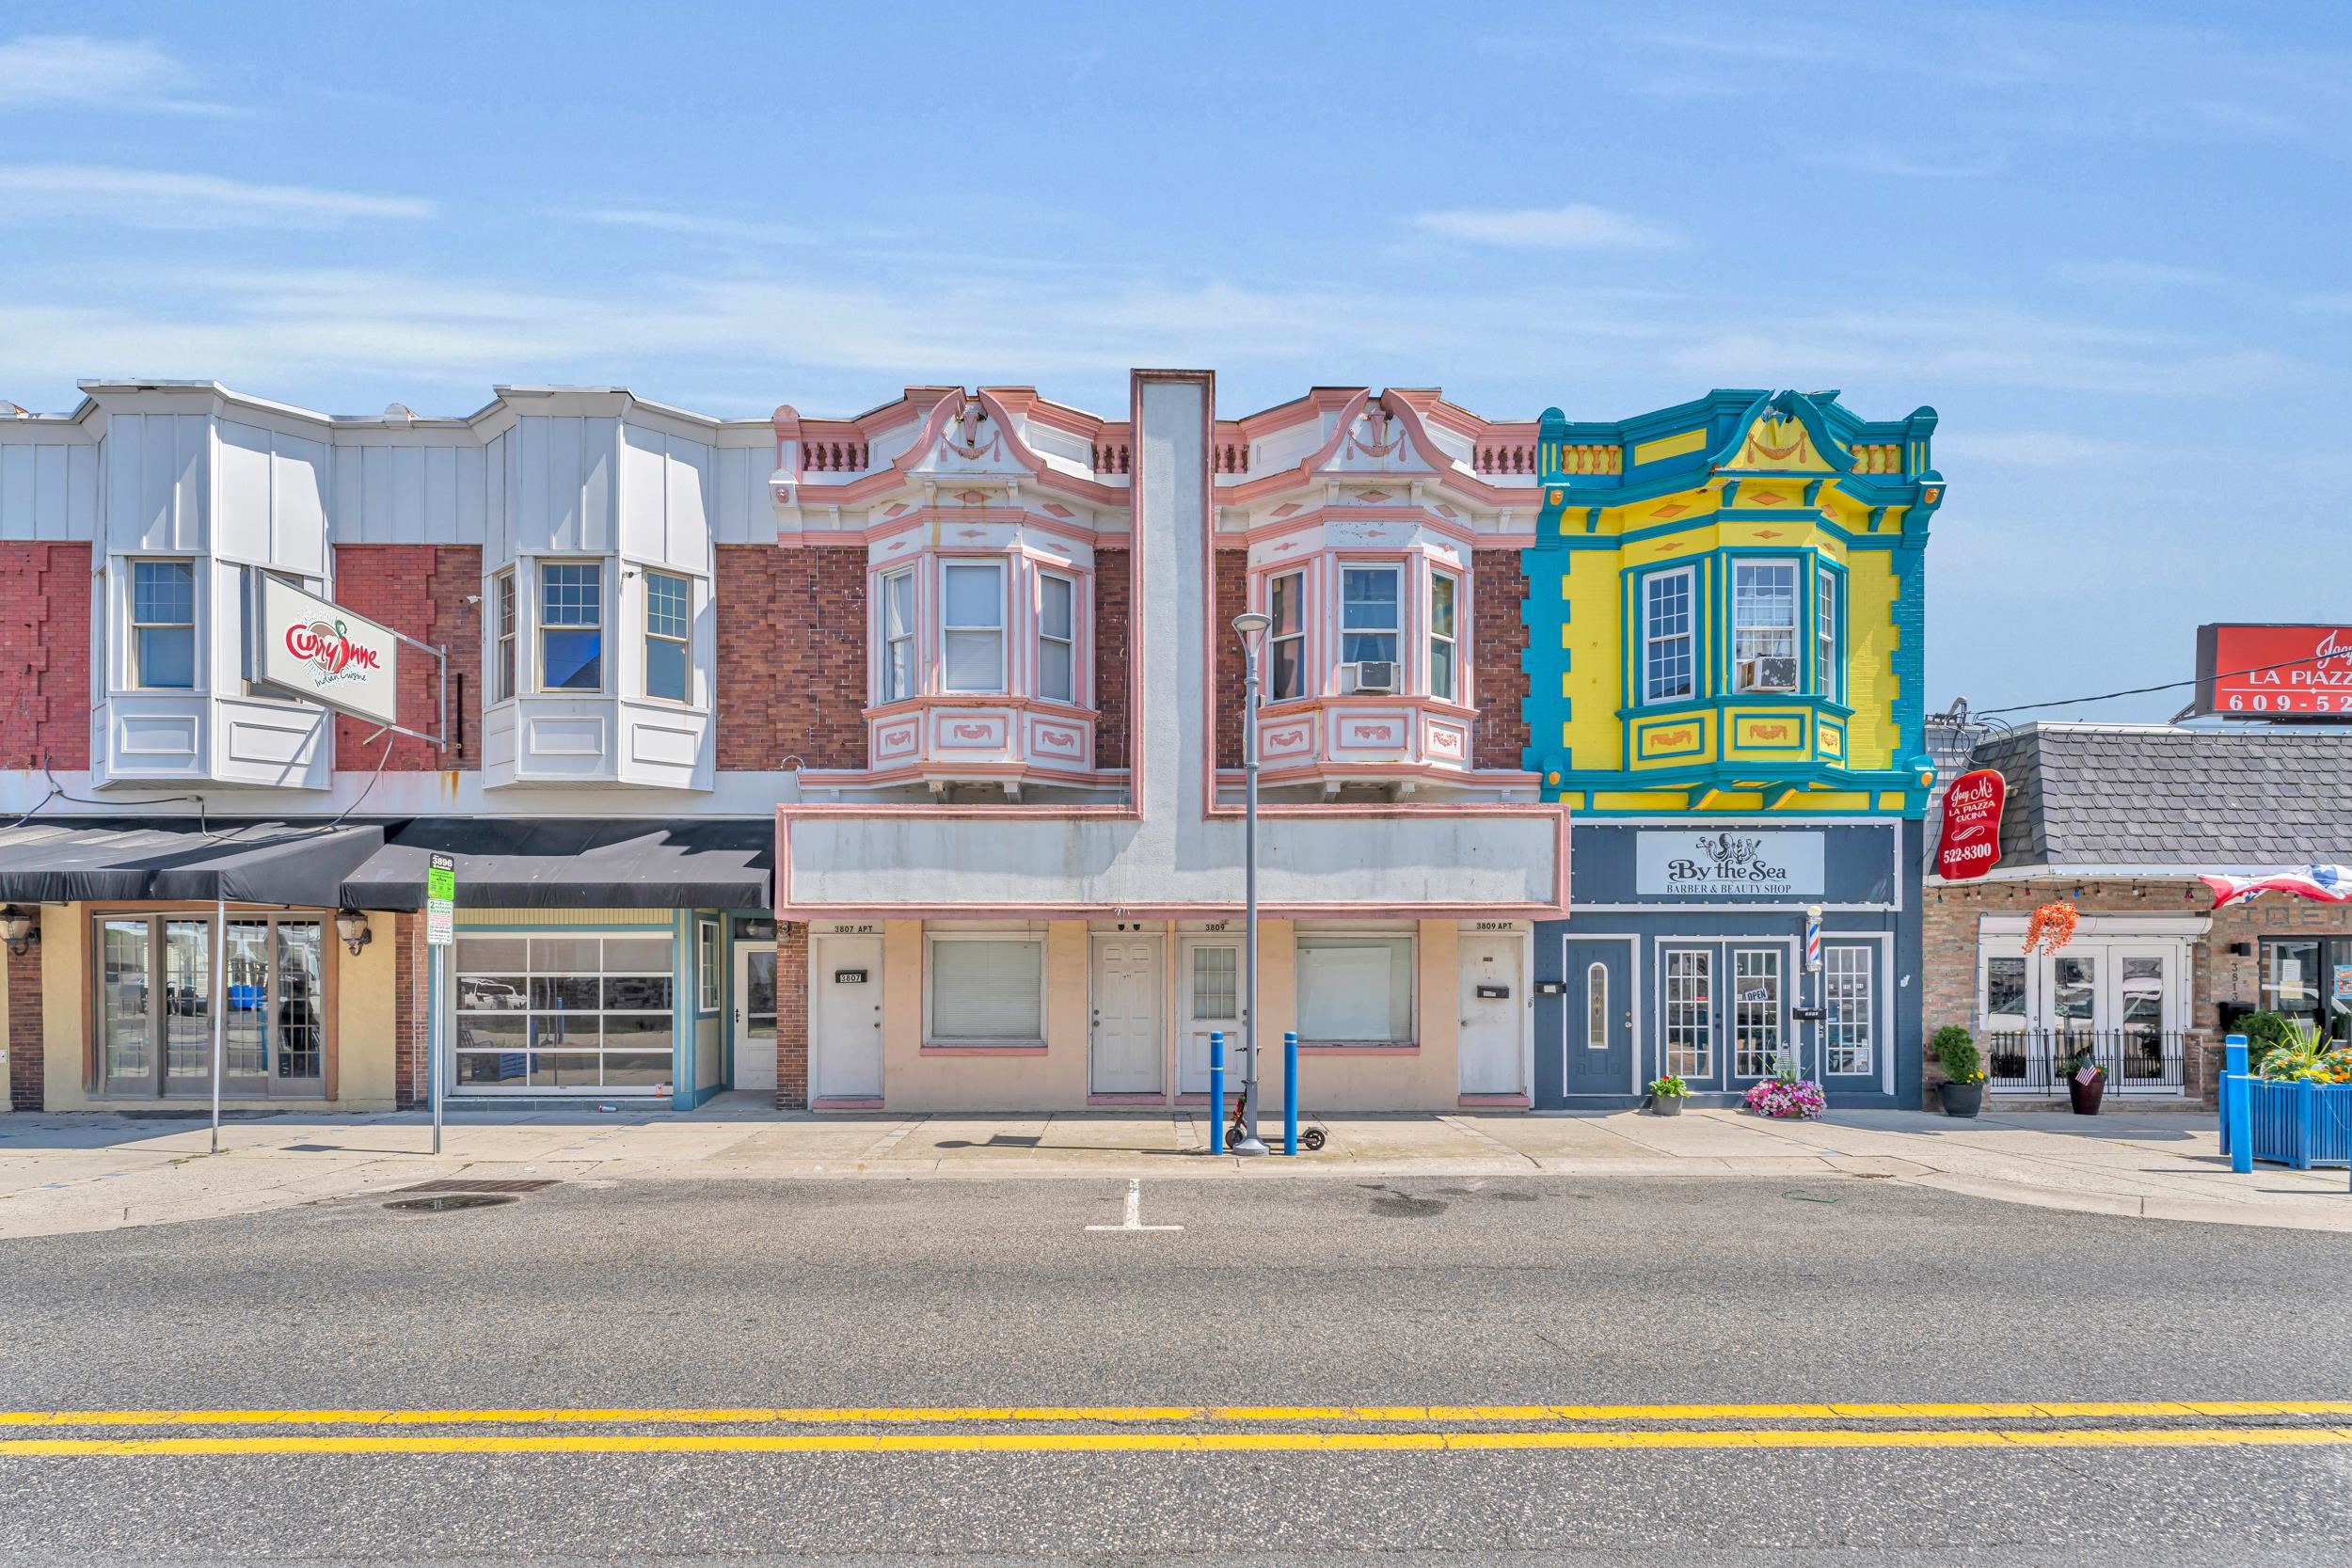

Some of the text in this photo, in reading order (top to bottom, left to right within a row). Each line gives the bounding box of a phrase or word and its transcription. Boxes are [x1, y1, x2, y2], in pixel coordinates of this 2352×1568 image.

[314, 669, 367, 688] Indian Cuisine
[2249, 670, 2281, 685] LA
[1950, 776, 1993, 808] Joey M's
[1948, 800, 1995, 817] LA PIAZZA
[1956, 810, 1987, 823] CUCINA
[1944, 842, 1992, 864] 522-8300
[432, 857, 453, 867] 3896
[1668, 859, 1787, 882] By the Sea
[1666, 885, 1791, 894] BARBER & BEAUTY SHOP
[430, 901, 436, 910] 2
[2231, 962, 2239, 1002] 3813
[1747, 990, 1767, 1002] OPEN
